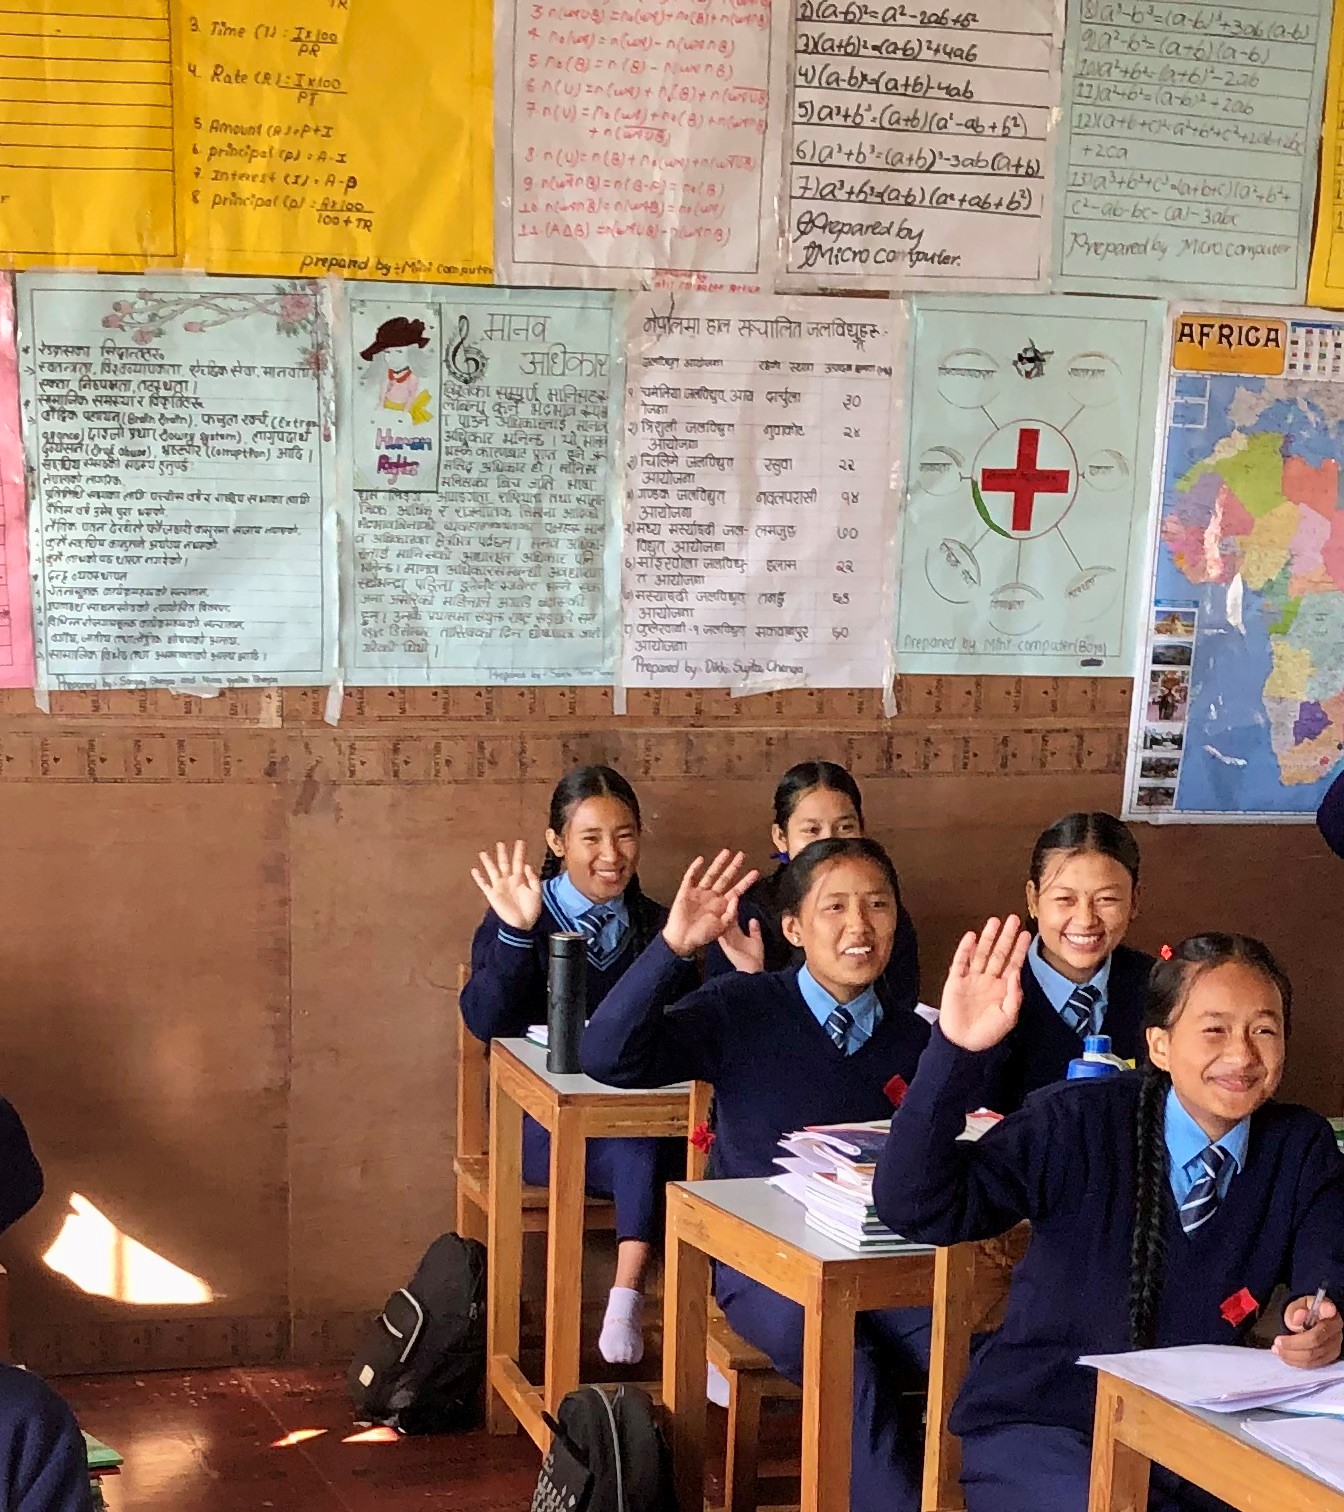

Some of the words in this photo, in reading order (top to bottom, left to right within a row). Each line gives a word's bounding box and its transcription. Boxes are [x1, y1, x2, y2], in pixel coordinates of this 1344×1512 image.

[210, 21, 246, 39] Time
[210, 64, 249, 85] Rate
[208, 119, 263, 139] Amount
[483, 312, 552, 342] मानव
[1176, 322, 1281, 350] AFRICA
[519, 342, 610, 378] अधिकार
